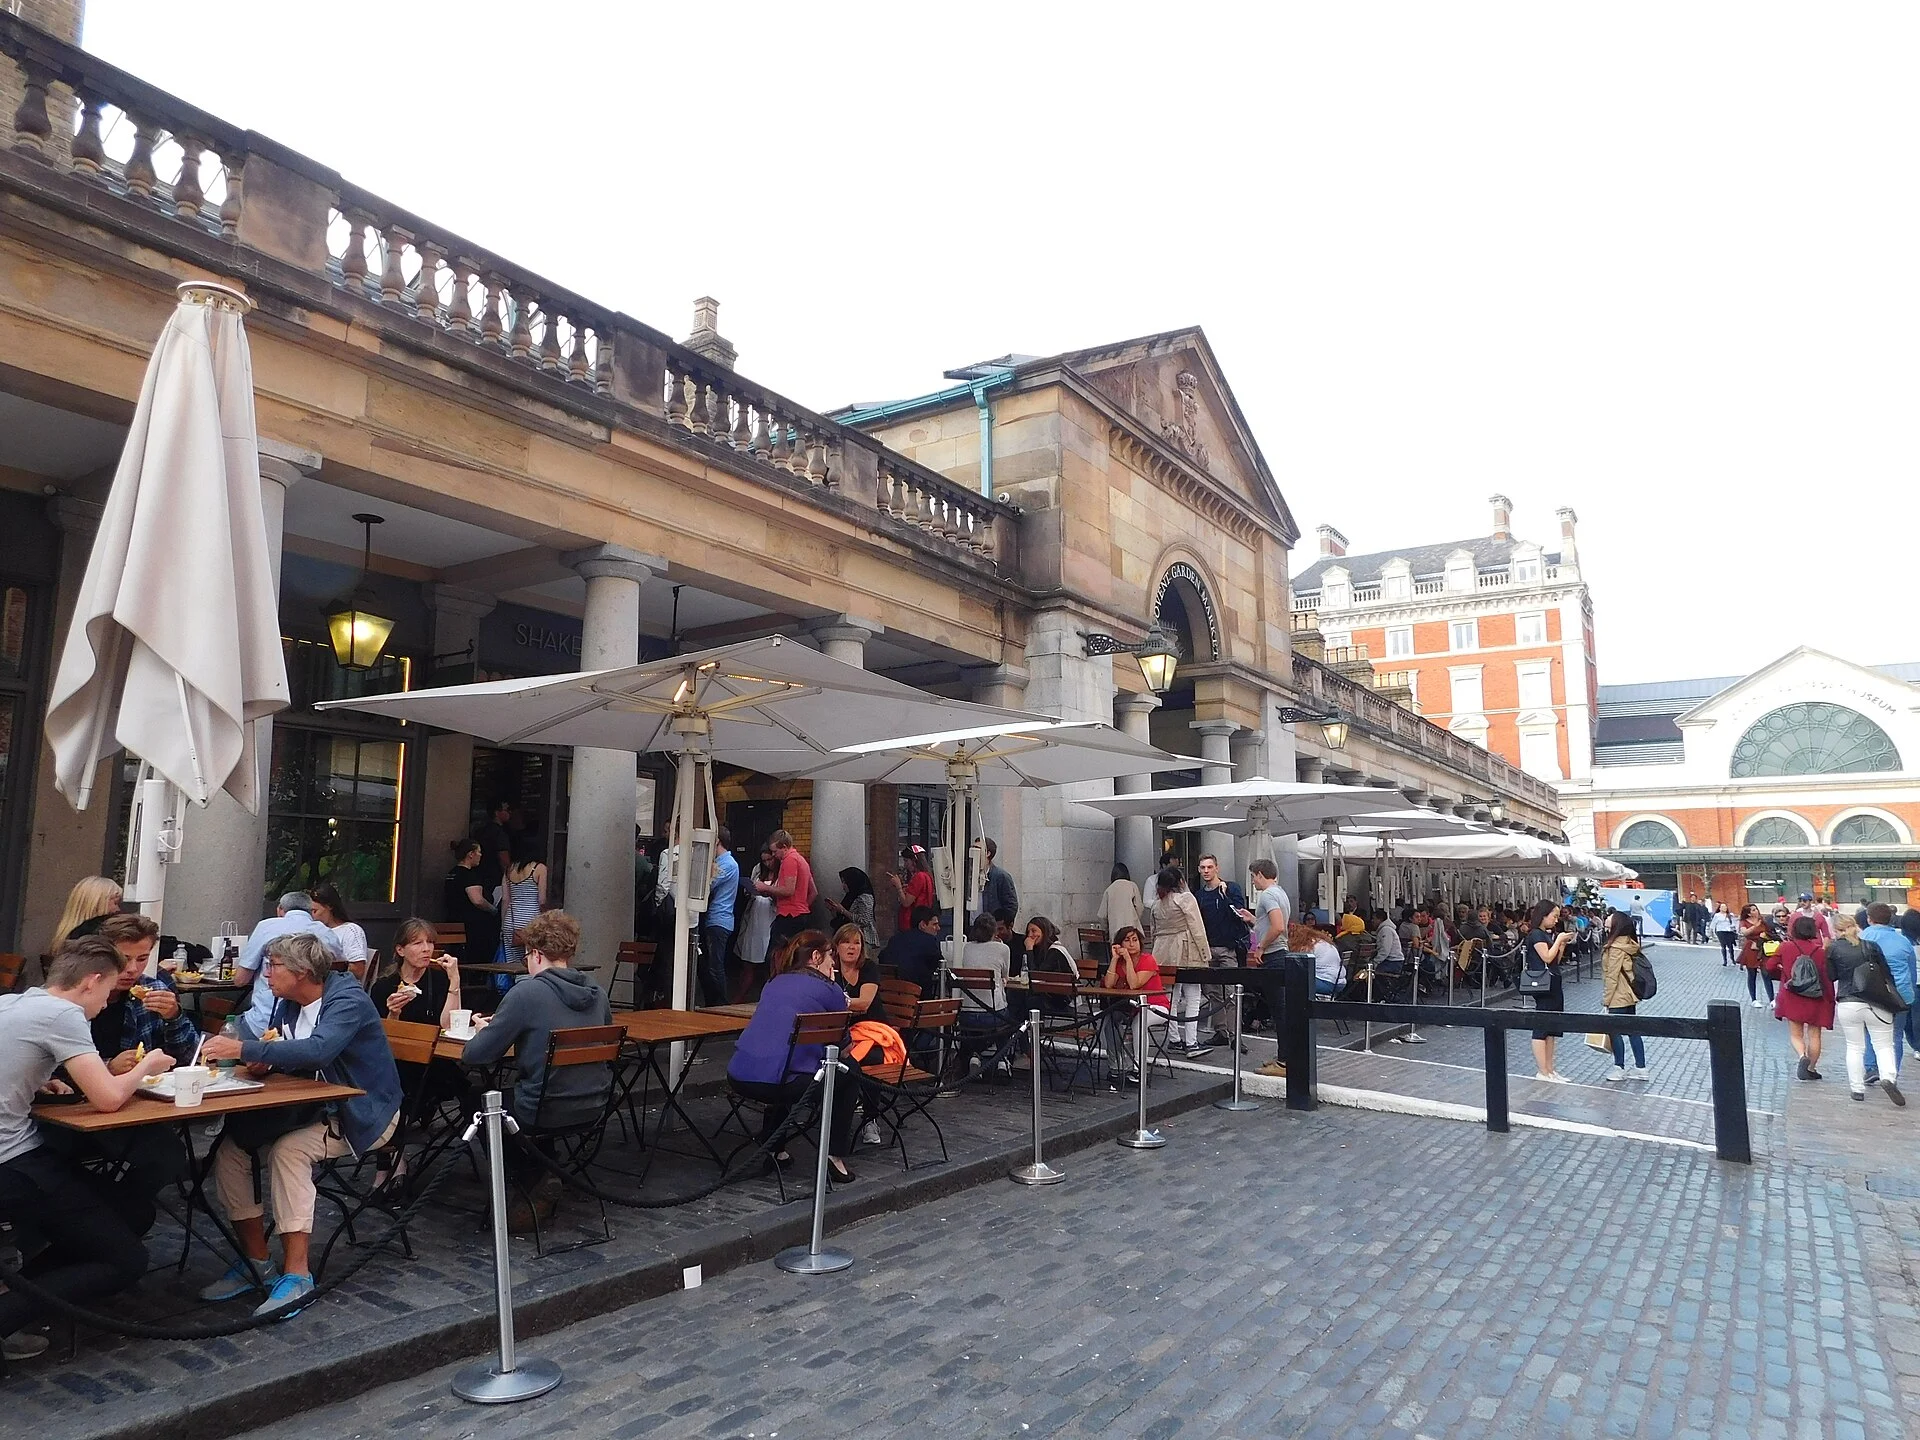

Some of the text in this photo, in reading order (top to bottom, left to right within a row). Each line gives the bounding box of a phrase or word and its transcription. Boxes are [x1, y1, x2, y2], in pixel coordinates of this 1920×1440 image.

[1153, 571, 1172, 624] OVENT
[1171, 564, 1201, 592] GARDEN
[515, 623, 583, 657] SHAKE
